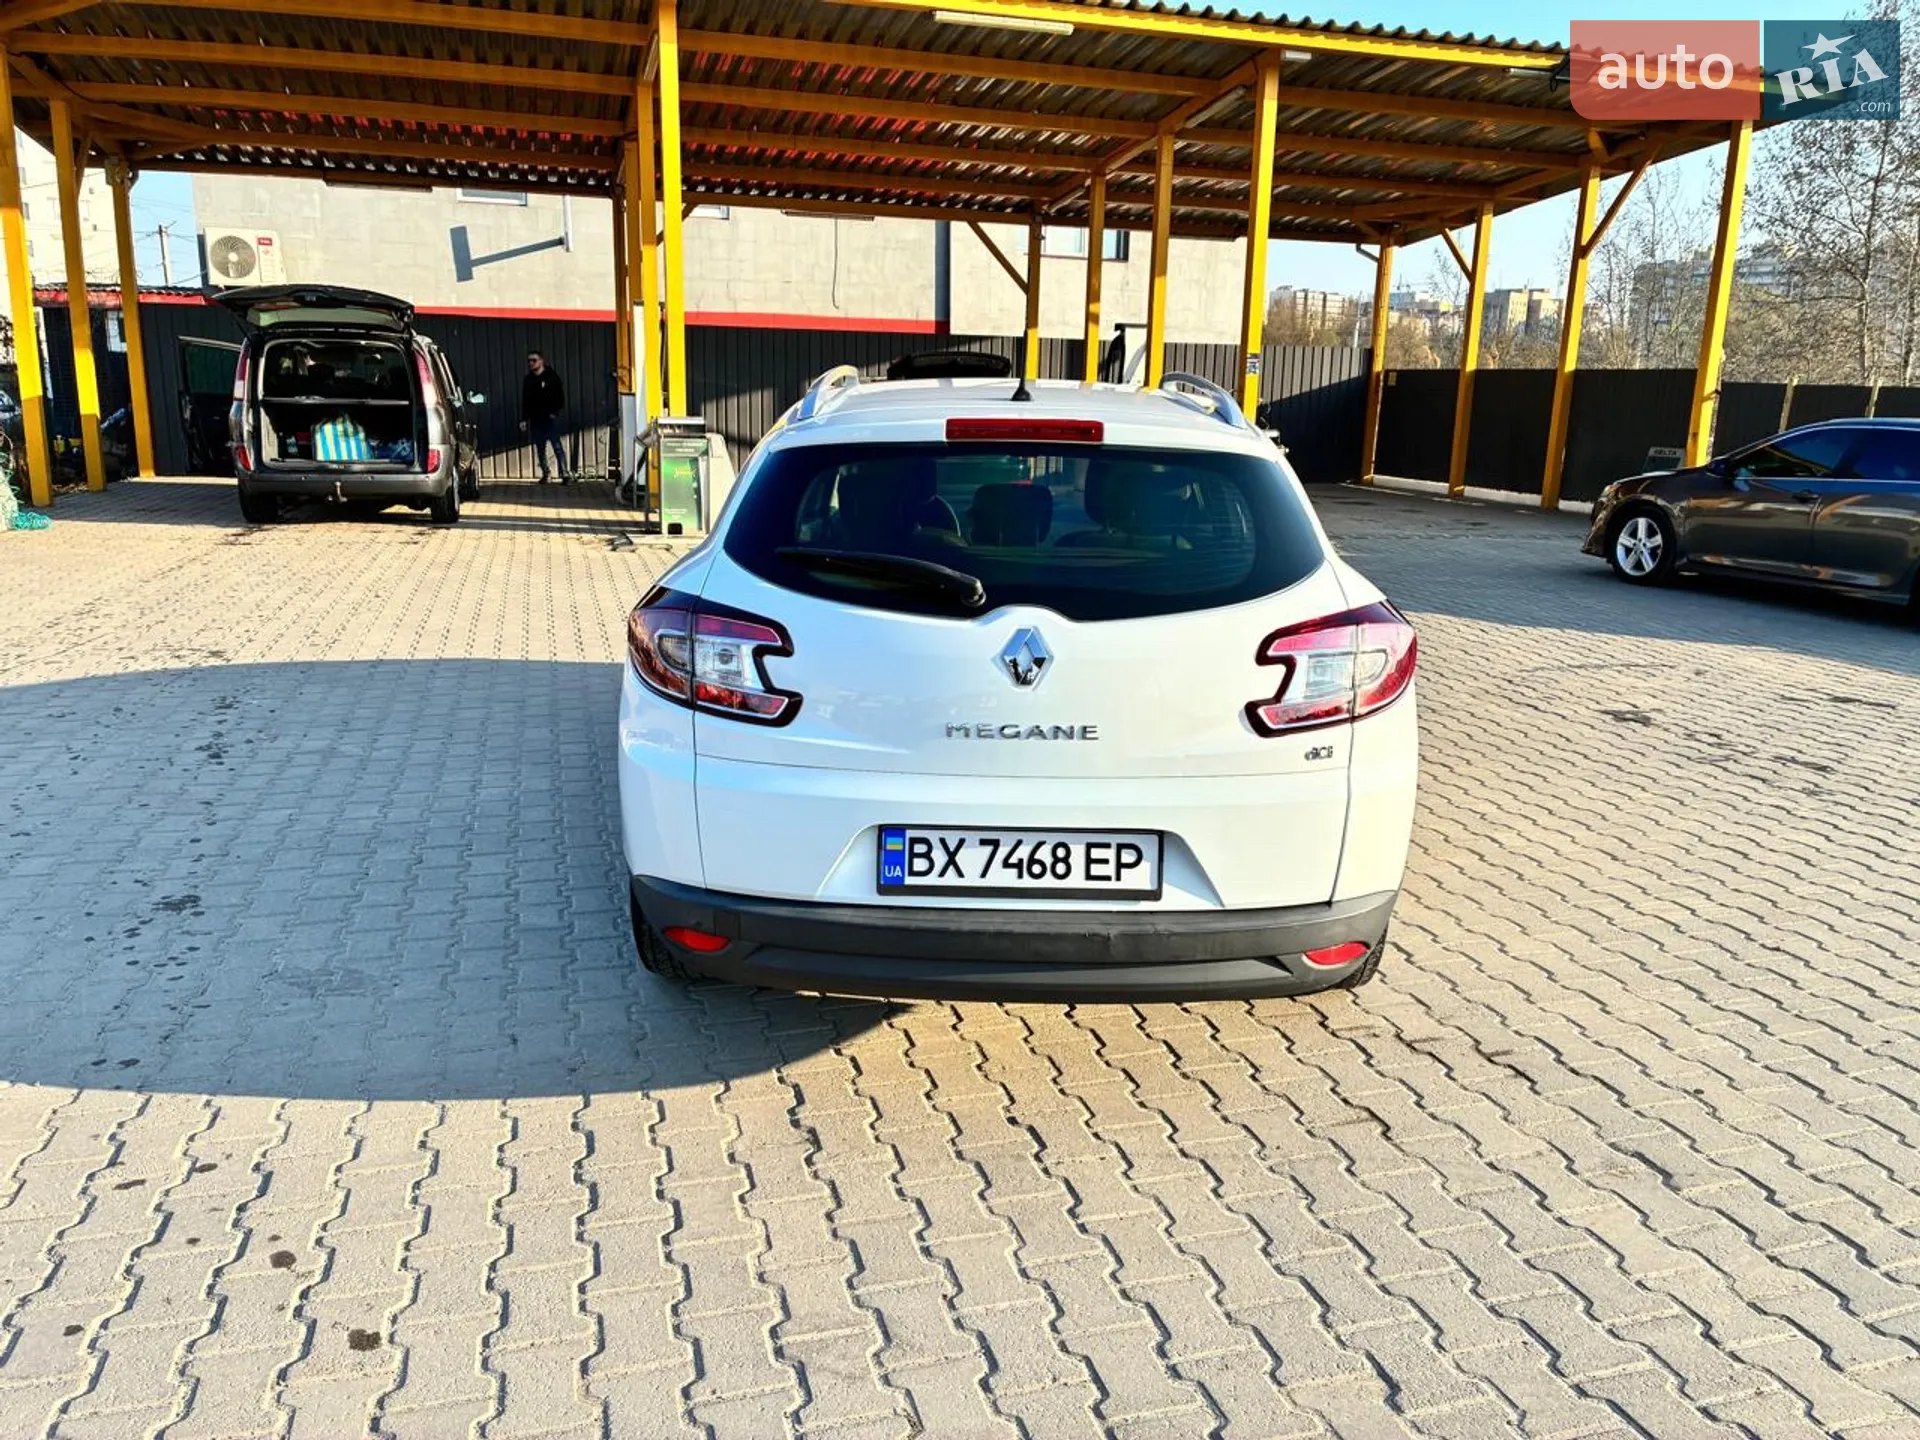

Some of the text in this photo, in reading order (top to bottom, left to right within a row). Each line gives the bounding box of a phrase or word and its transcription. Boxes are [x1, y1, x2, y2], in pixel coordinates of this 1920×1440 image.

[946, 722, 1099, 740] MEGANE
[908, 836, 1143, 882] BX 7468 EP
[885, 865, 902, 878] UA
